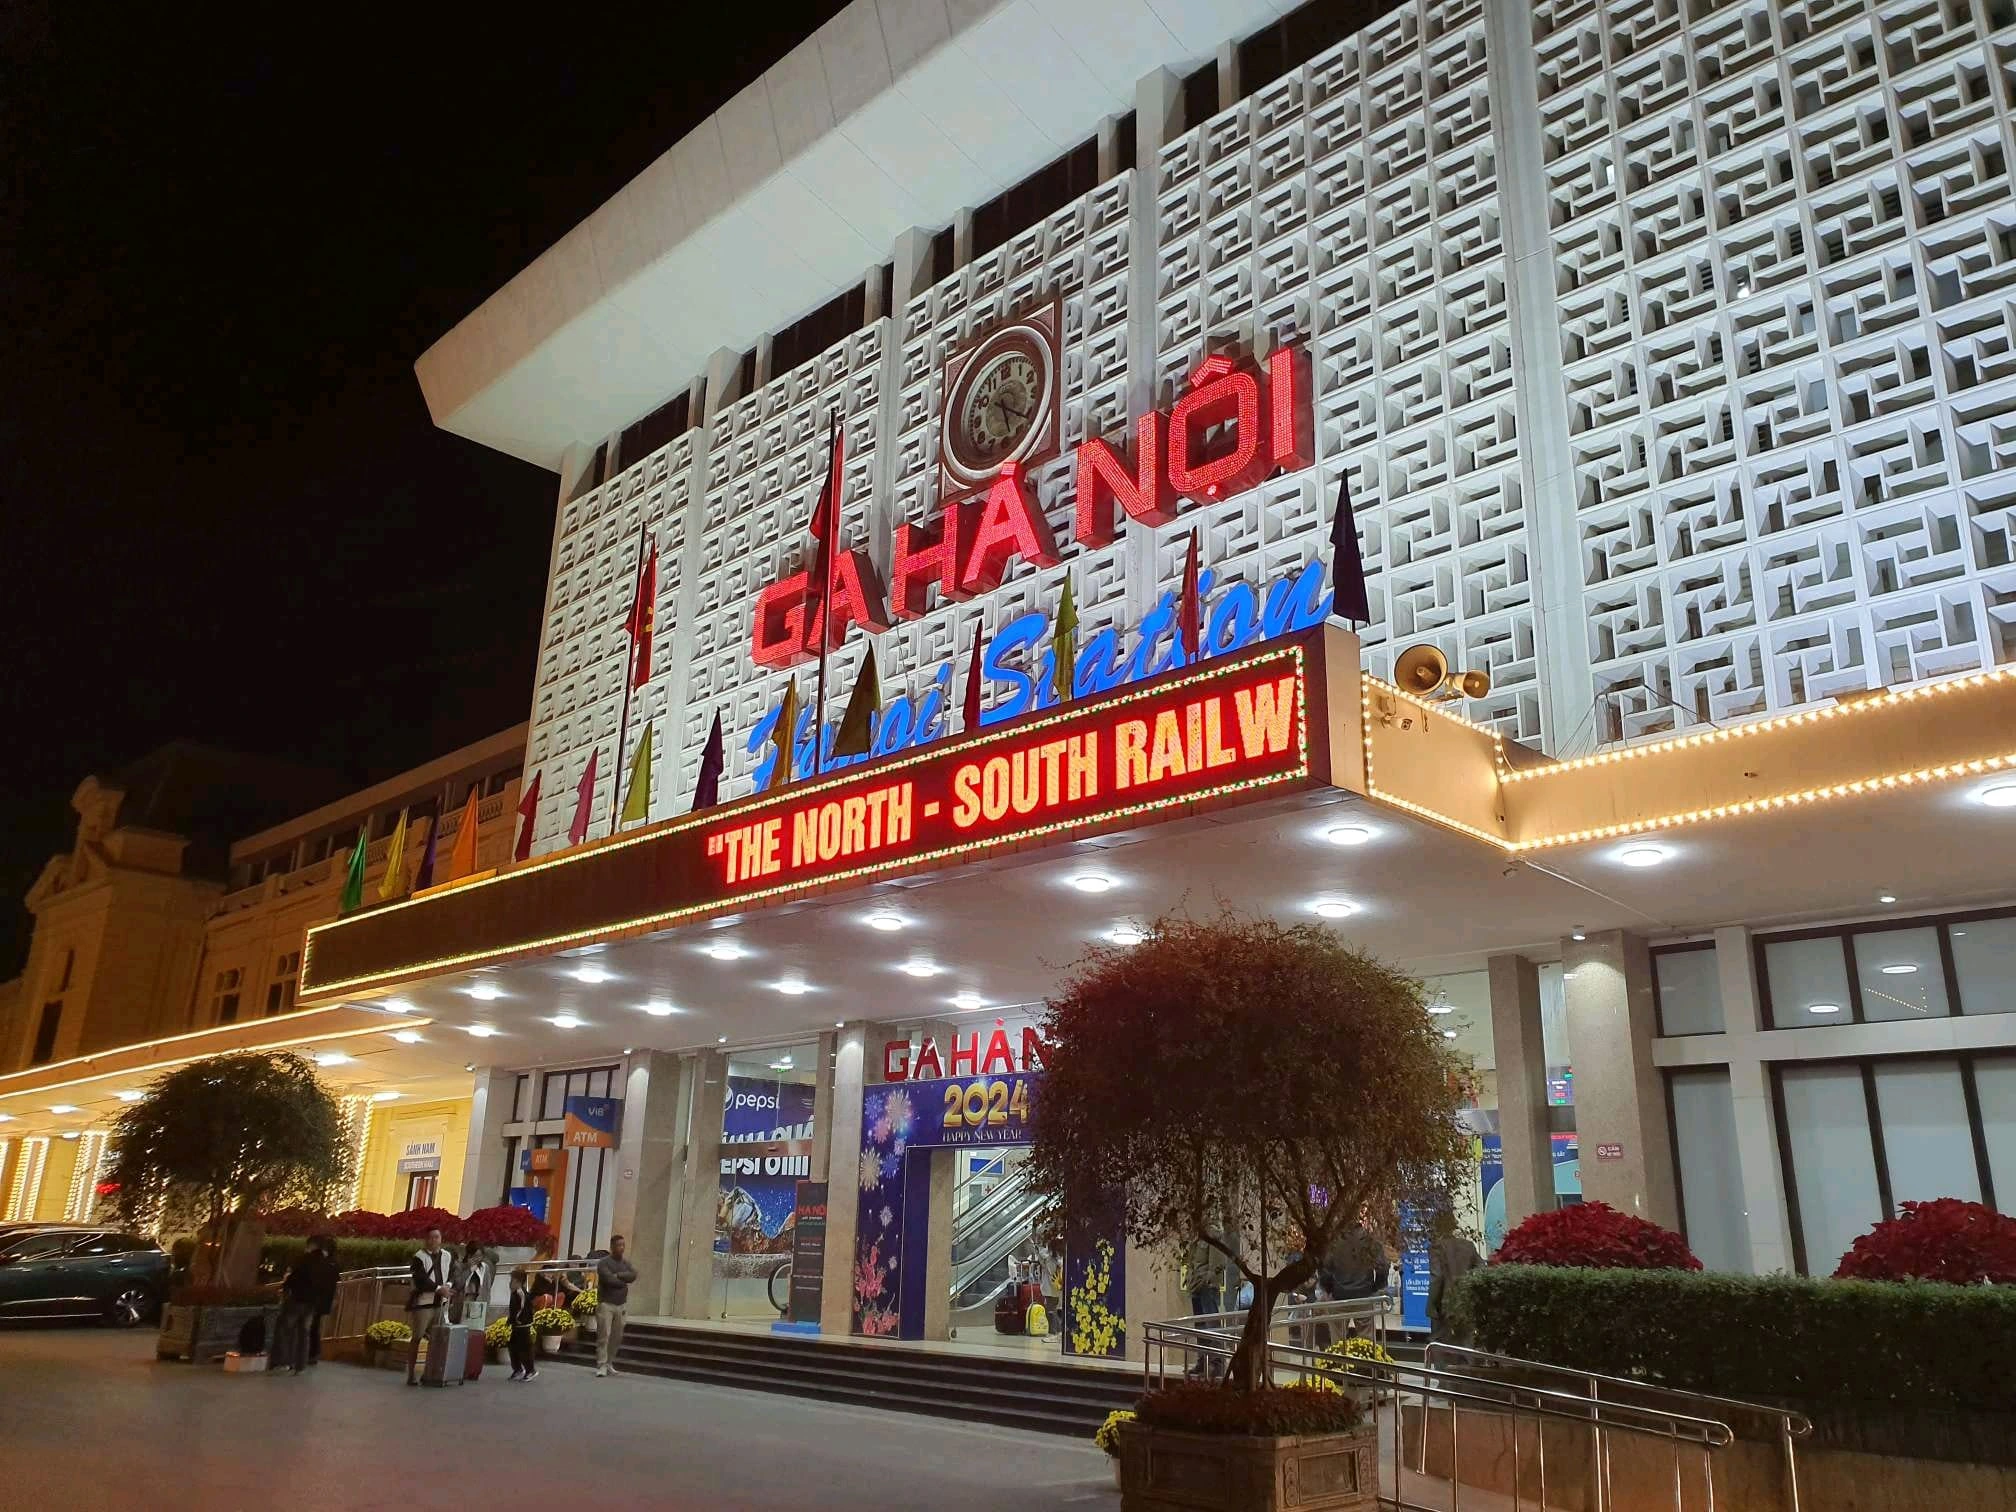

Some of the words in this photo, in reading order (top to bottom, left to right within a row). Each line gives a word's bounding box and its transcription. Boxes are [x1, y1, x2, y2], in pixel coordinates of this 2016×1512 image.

[751, 548, 876, 667] GA
[1075, 347, 1297, 543] NỘI
[791, 782, 914, 868] NORTH
[952, 731, 1099, 829] SOUTH
[883, 1037, 943, 1081] GA
[735, 1093, 780, 1112] pepsi
[943, 1079, 1031, 1128] 2024
[573, 1131, 598, 1143] ATM
[943, 1131, 971, 1143] HAPPY
[974, 1129, 994, 1142] NEW
